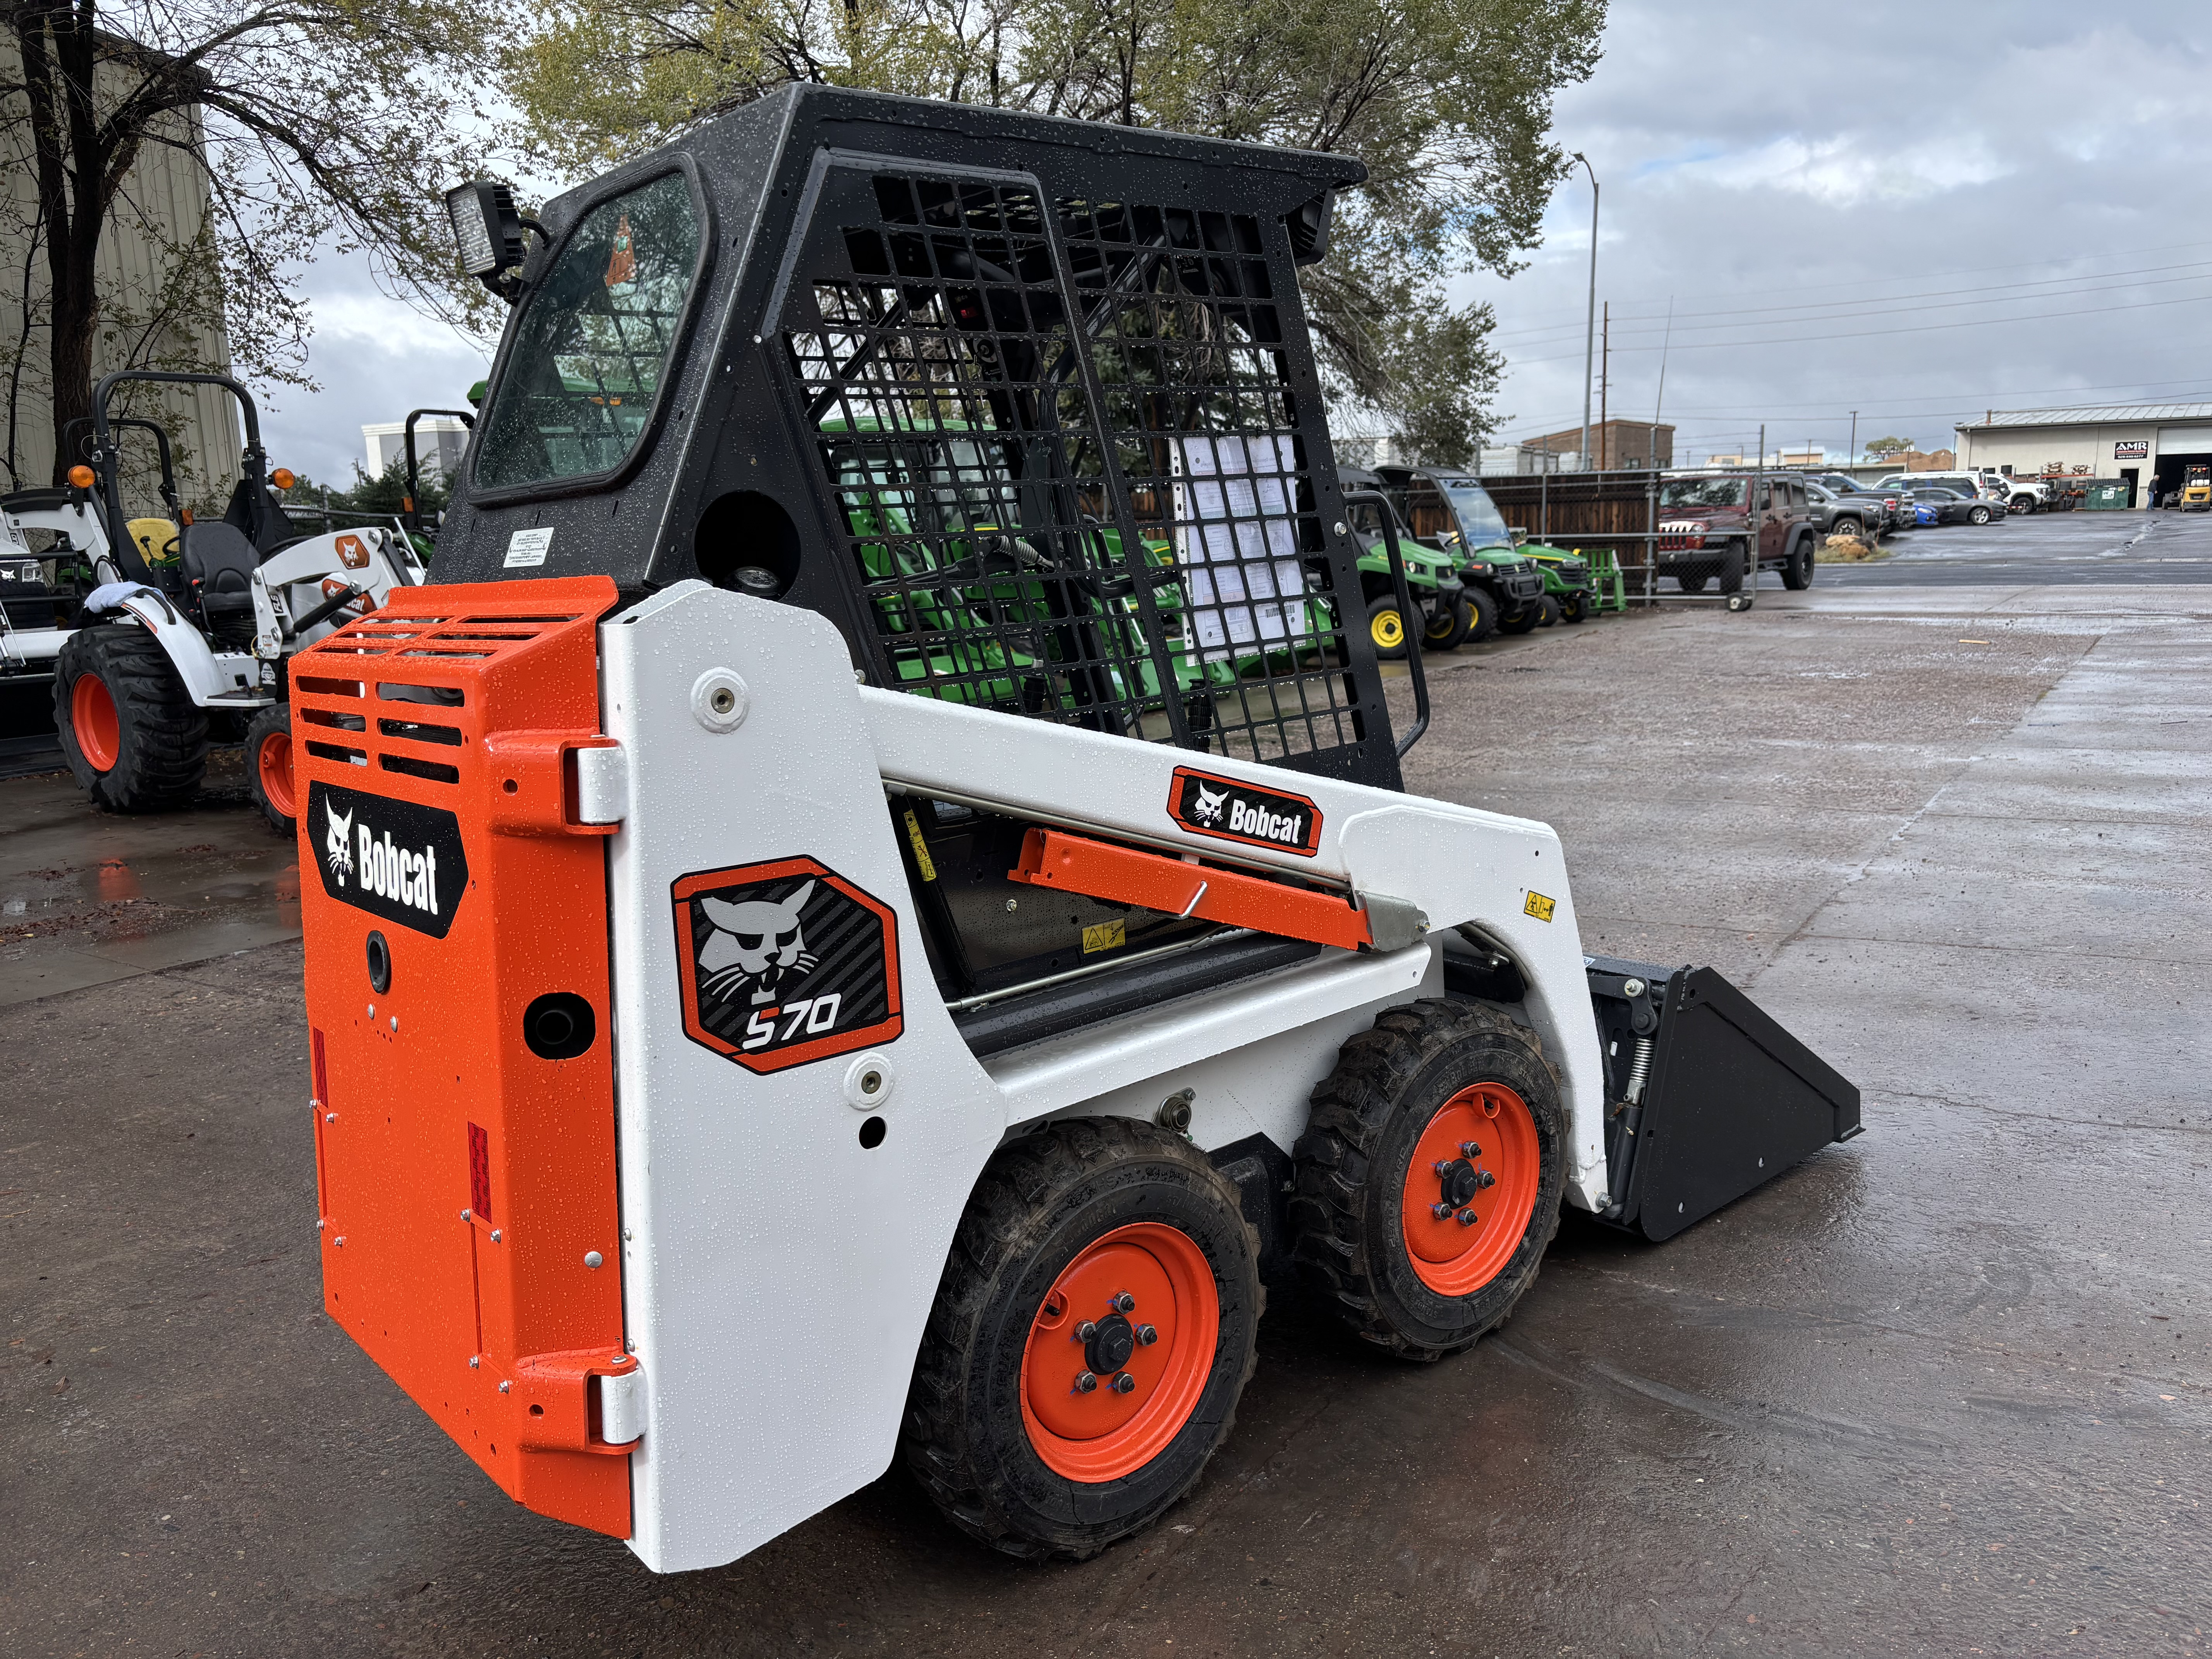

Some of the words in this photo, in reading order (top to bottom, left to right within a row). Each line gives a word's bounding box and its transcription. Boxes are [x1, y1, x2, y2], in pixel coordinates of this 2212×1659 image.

[2116, 442, 2147, 451] AMR
[347, 598, 365, 611] cat
[1229, 799, 1302, 844] Bobcat
[358, 824, 438, 915] Bobcat
[742, 993, 842, 1050] S70
